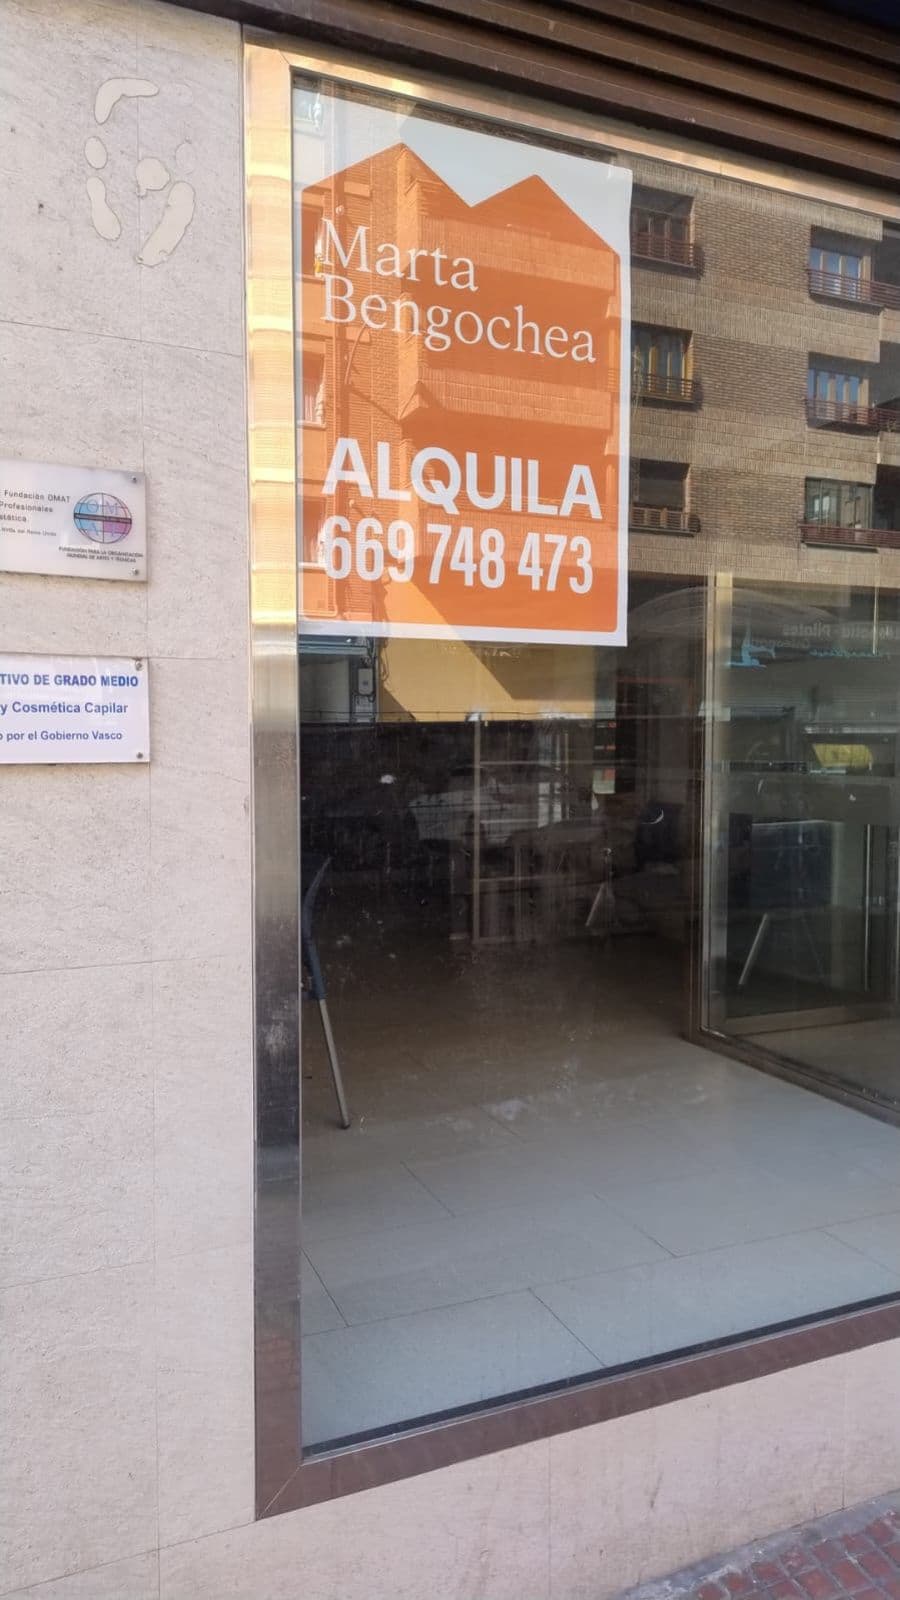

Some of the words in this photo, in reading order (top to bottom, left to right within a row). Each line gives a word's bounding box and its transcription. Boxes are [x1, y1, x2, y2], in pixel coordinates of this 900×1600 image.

[321, 219, 478, 292] Marta
[320, 274, 596, 363] Bengochea
[321, 437, 603, 520] ALQUILA
[47, 493, 70, 503] OMAT
[0, 501, 53, 513] Profesionales
[323, 515, 415, 584] 669
[427, 523, 506, 589] 748
[518, 531, 593, 595] 473
[0, 673, 29, 686] TIVO
[33, 674, 50, 686] DE
[54, 674, 97, 687] GRADO
[100, 675, 139, 688] MEDIO
[0, 703, 7, 716] y
[12, 701, 81, 714] Cosmética
[84, 702, 129, 716] Capilar
[6, 732, 25, 742] por
[28, 730, 37, 740] el
[40, 730, 89, 740] Gobierno
[92, 731, 122, 740] Vasco
